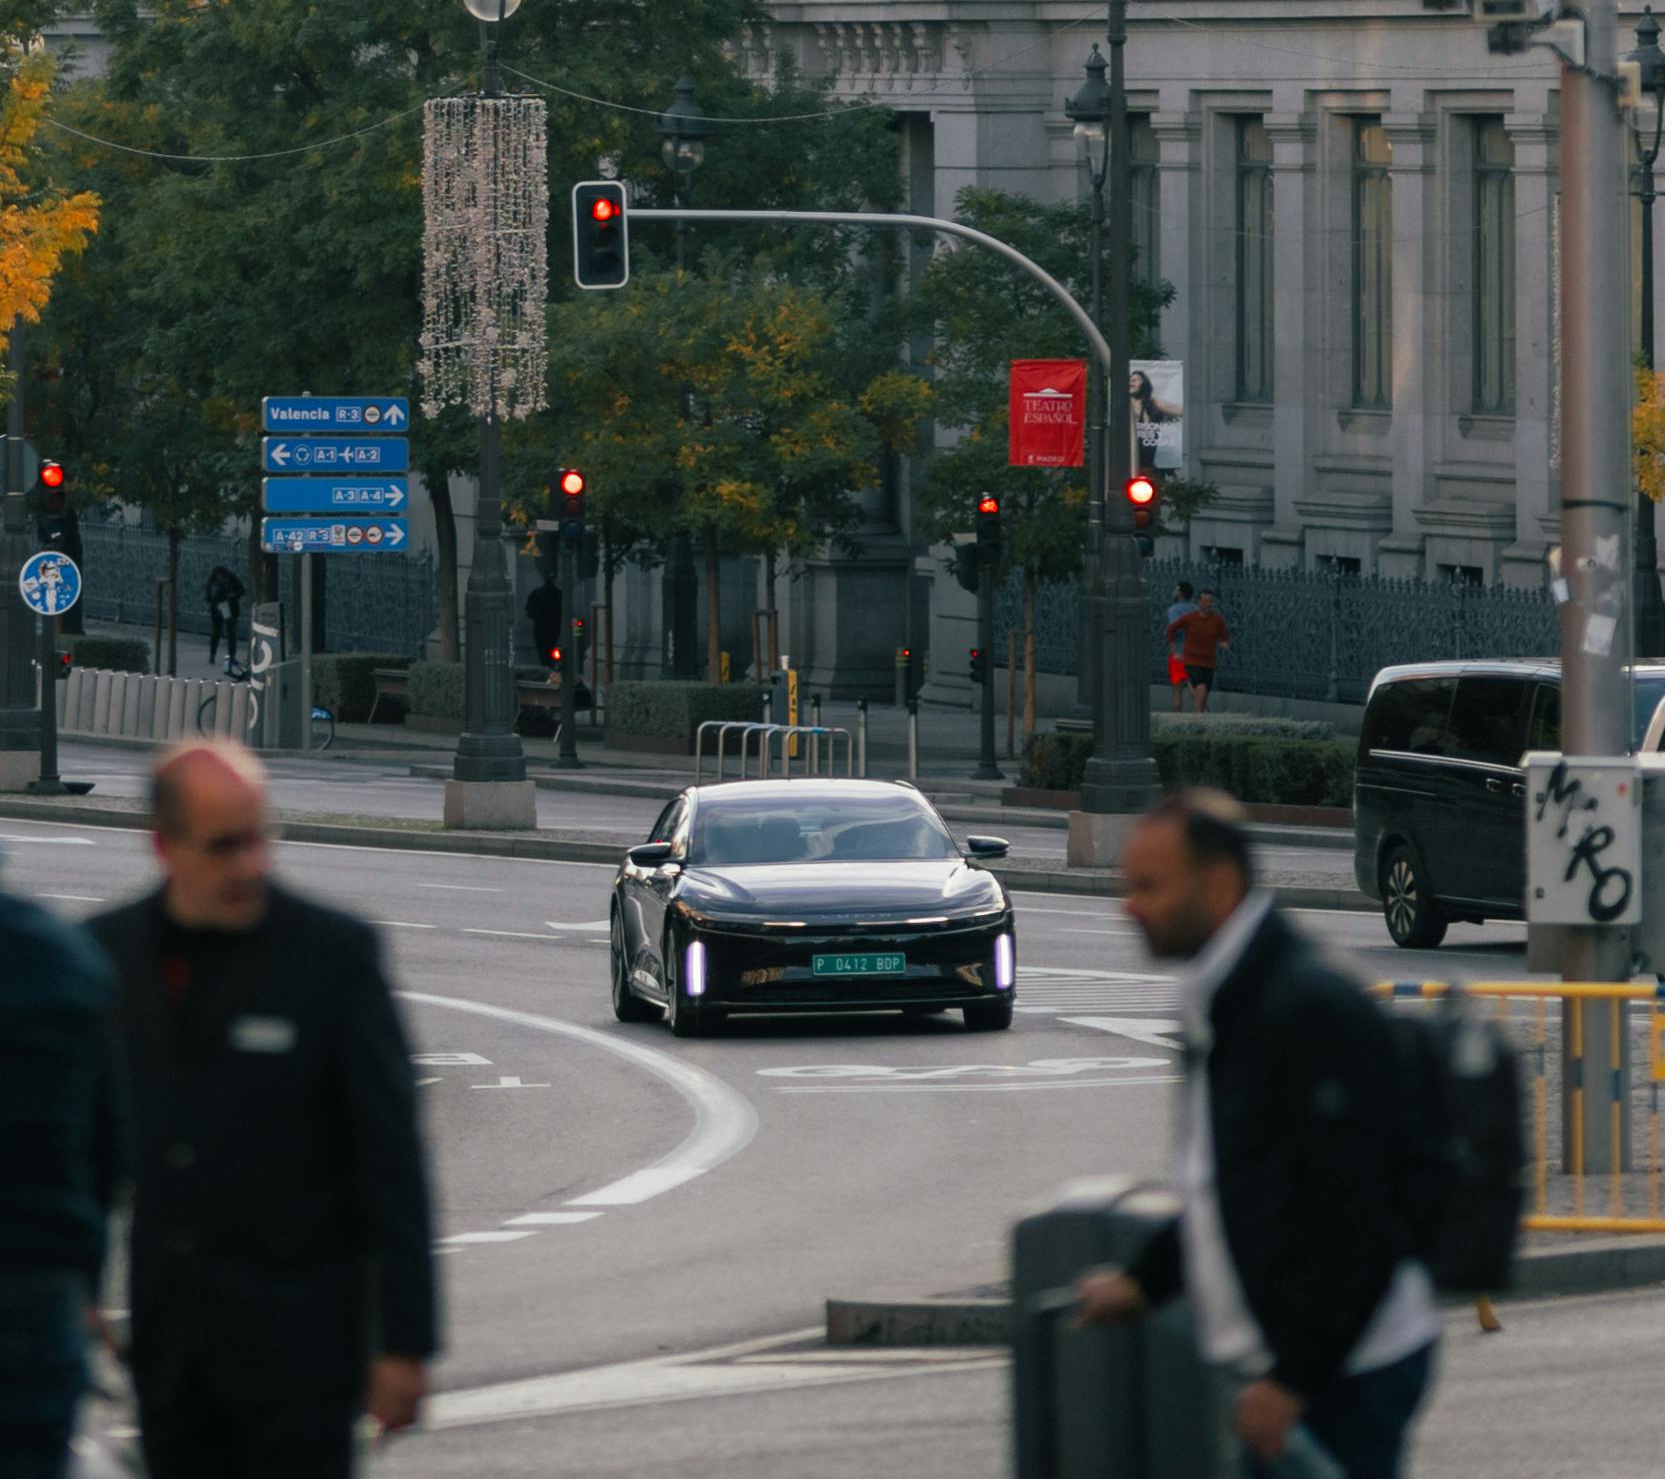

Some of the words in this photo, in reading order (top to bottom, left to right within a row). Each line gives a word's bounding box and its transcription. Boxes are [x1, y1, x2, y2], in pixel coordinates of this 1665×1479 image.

[1023, 399, 1073, 412] TEATRO
[270, 406, 331, 421] Valencia
[338, 408, 360, 420] R-3
[1023, 412, 1079, 424] ESPAÑOL
[316, 449, 336, 460] A-1
[358, 449, 378, 460] A-2
[335, 490, 356, 501] A-3
[360, 490, 382, 501] A-4
[275, 530, 305, 542] A-42
[816, 957, 825, 971] P
[835, 957, 869, 971] 0412
